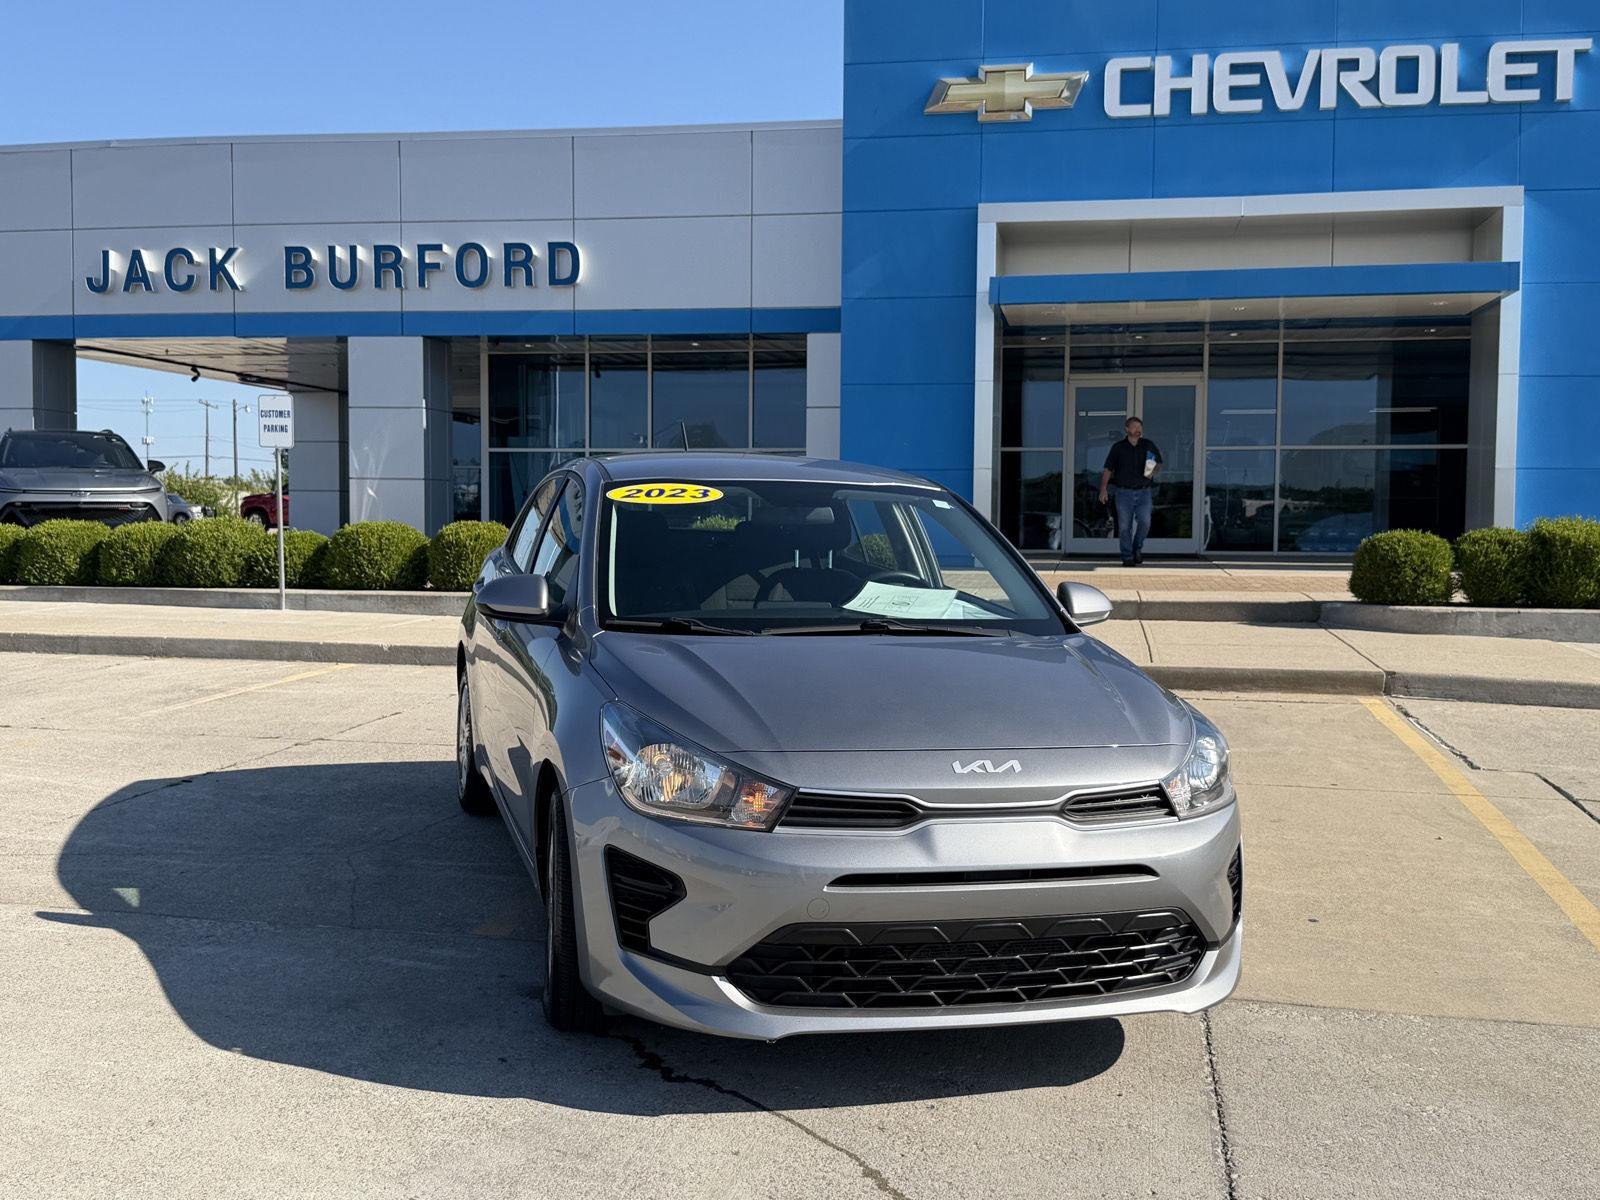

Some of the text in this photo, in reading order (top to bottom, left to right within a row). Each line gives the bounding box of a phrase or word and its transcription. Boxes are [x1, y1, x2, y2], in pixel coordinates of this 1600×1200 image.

[1103, 37, 1594, 119] CHEVROLET
[84, 241, 583, 294] JACK BURFORD
[260, 409, 291, 418] CUSTOMER
[263, 424, 289, 433] PARKING
[620, 487, 710, 499] 2023
[951, 759, 1022, 774] KIA
